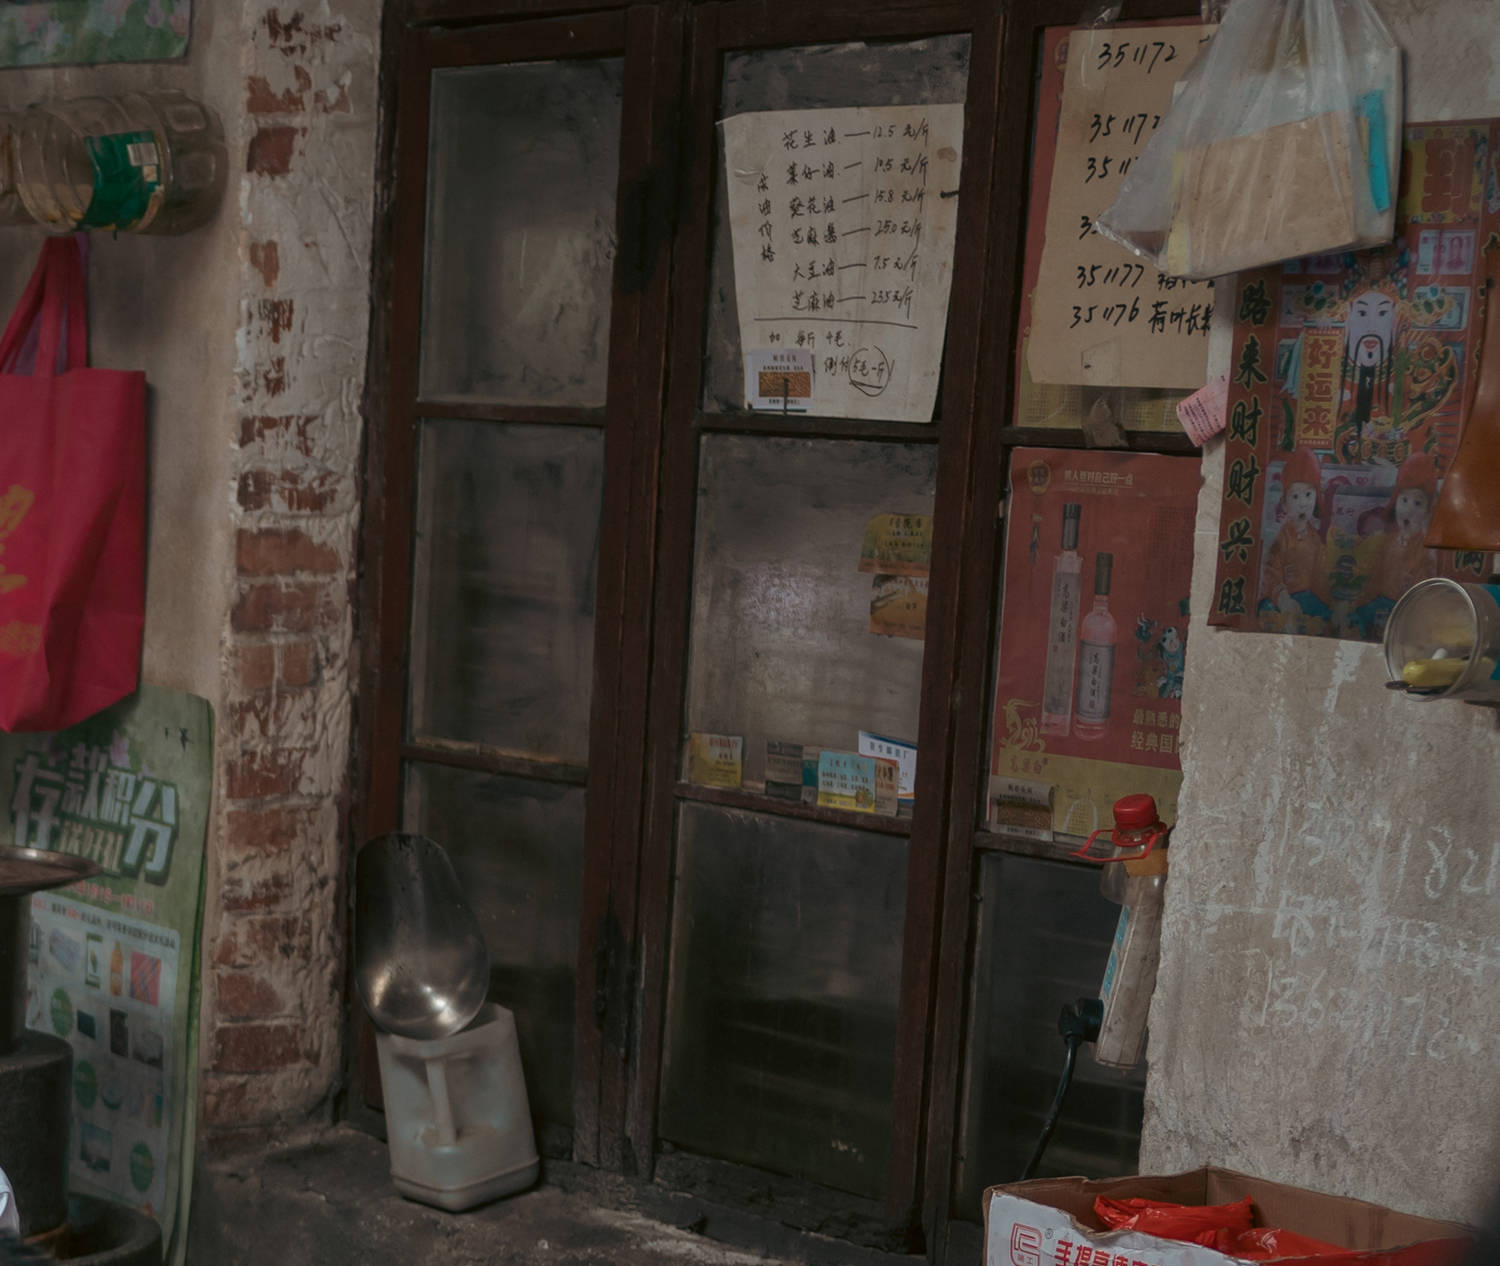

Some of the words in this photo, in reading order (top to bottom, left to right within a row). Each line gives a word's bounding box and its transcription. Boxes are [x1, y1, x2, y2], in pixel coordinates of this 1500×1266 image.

[1098, 42, 1176, 74] 351172
[782, 126, 837, 150] 花生油
[1085, 156, 1138, 184] 3511
[1077, 263, 1145, 289] 351177
[1070, 296, 1140, 328] 351176
[1305, 338, 1337, 436] 好运来
[12, 744, 176, 873] 存款积分
